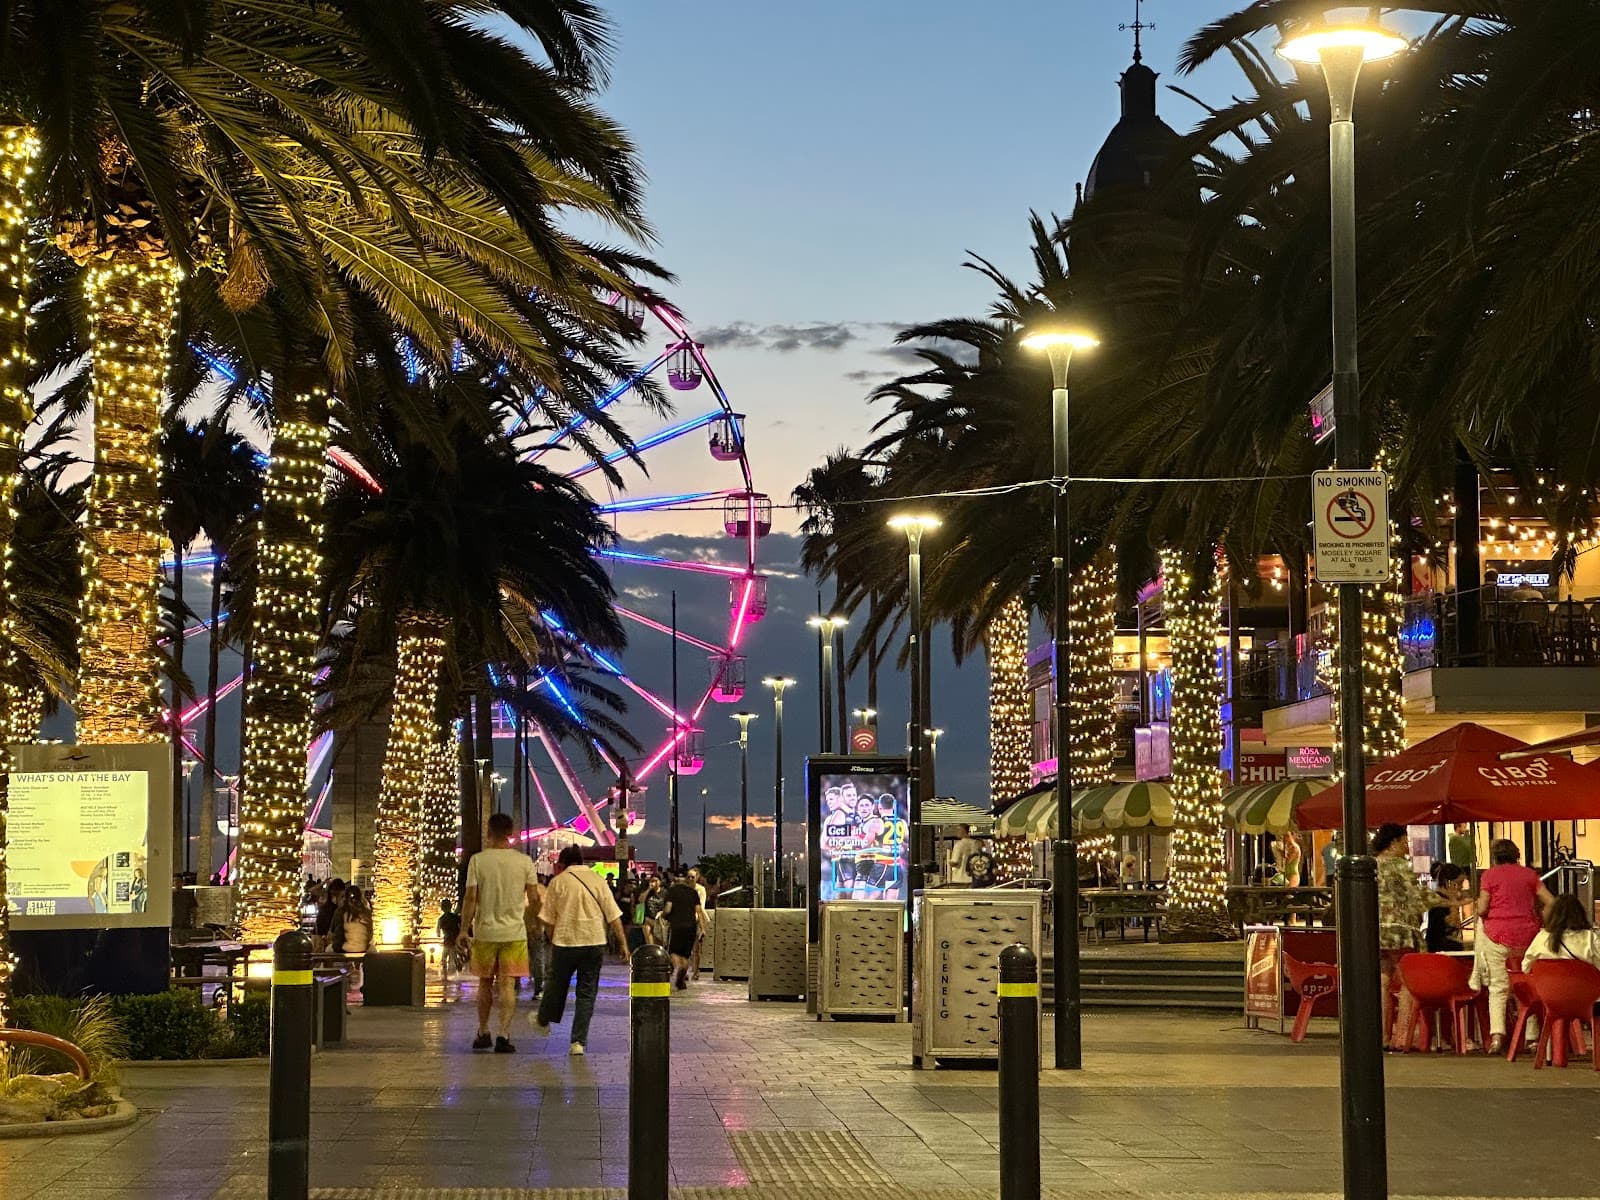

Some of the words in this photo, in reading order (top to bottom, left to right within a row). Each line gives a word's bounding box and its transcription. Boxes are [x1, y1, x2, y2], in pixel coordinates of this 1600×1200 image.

[1318, 477, 1332, 487] NO
[1336, 476, 1382, 487] SMOKING
[16, 774, 54, 782] WHAT'S
[57, 774, 74, 782] ON
[76, 774, 89, 782] AT
[91, 774, 110, 782] THE
[112, 774, 131, 782] BAY
[1374, 769, 1428, 783] CIBO
[1478, 766, 1548, 780] CIBO
[828, 825, 846, 836] Get
[882, 821, 904, 844] 29
[828, 838, 843, 846] the
[940, 940, 949, 1018] GLENELG
